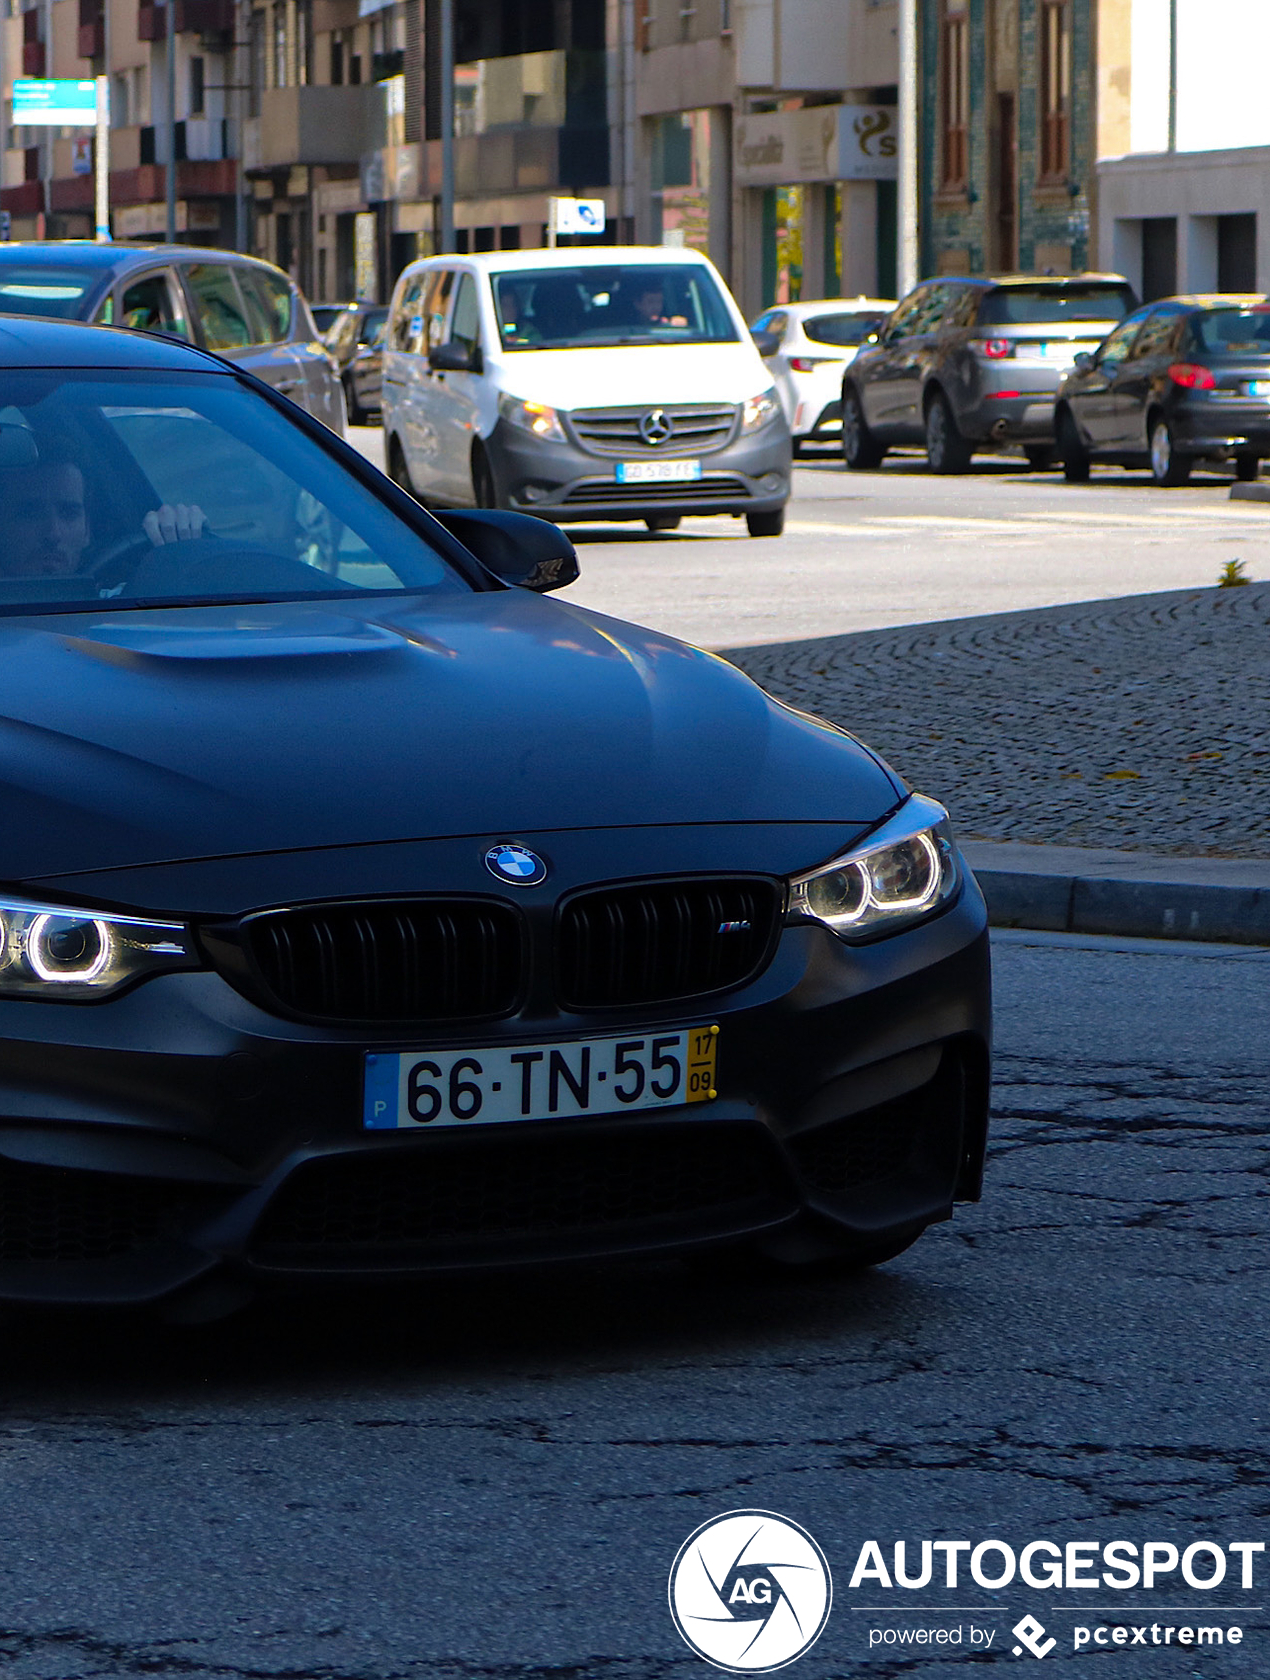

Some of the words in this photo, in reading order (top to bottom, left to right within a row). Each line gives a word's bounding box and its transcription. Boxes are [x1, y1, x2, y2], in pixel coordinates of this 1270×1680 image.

[488, 846, 533, 859] BMW
[694, 1034, 713, 1056] 17
[690, 1071, 711, 1093] 09
[374, 1100, 387, 1118] P
